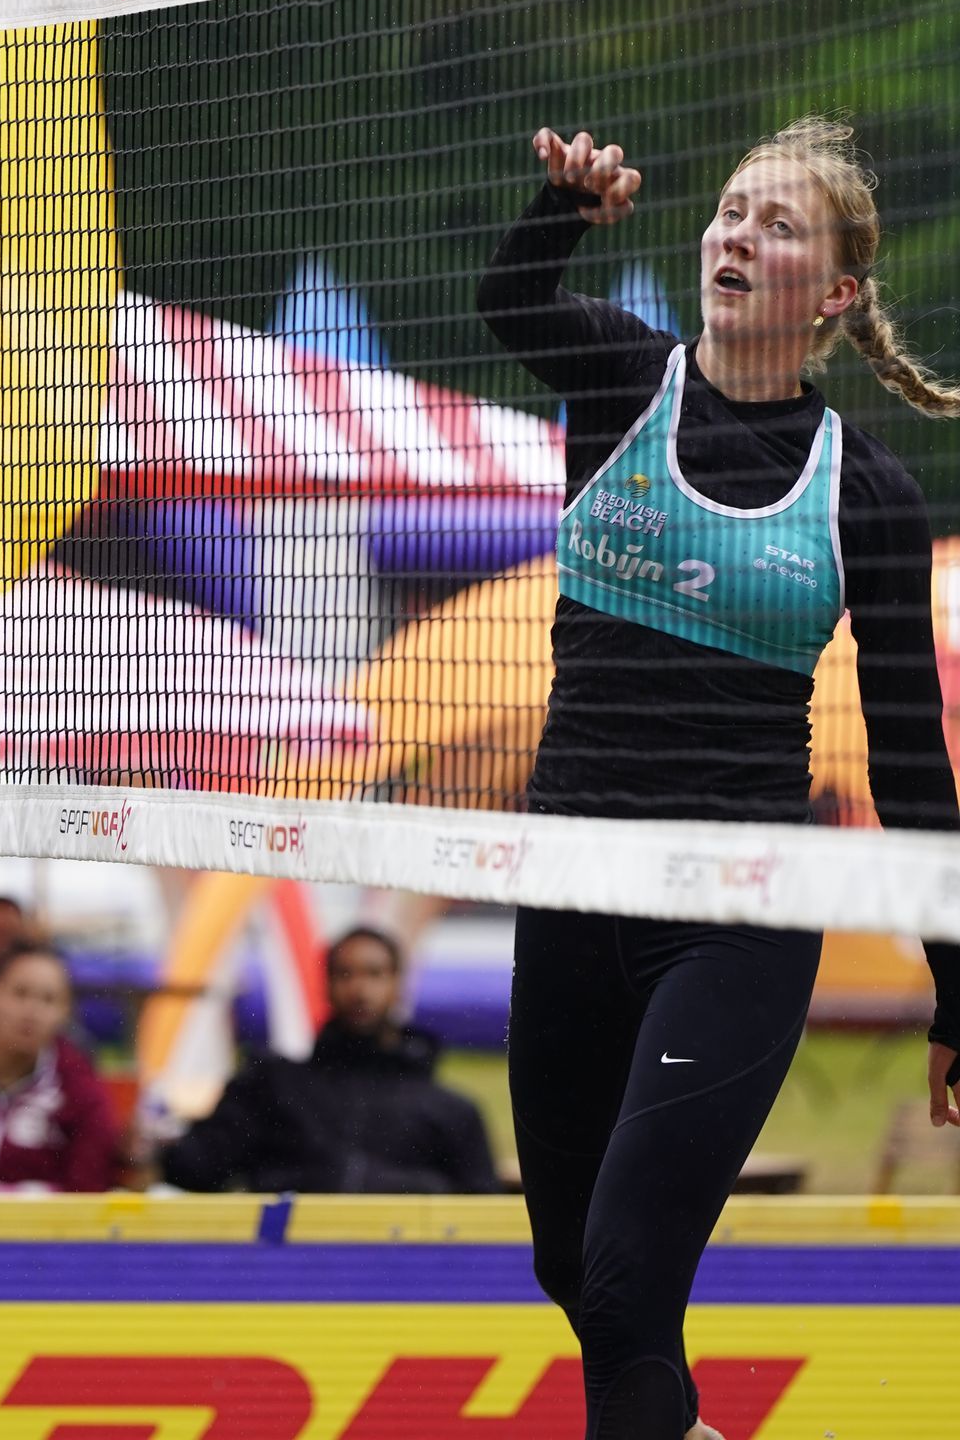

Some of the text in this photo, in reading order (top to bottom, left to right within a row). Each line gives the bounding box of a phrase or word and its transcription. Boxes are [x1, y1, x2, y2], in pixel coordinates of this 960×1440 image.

[589, 501, 665, 538] BEACH
[595, 488, 670, 523] EREDIVISIE
[567, 518, 716, 602] Robijn 2
[764, 544, 816, 572] STAR
[768, 562, 819, 589] nevobo
